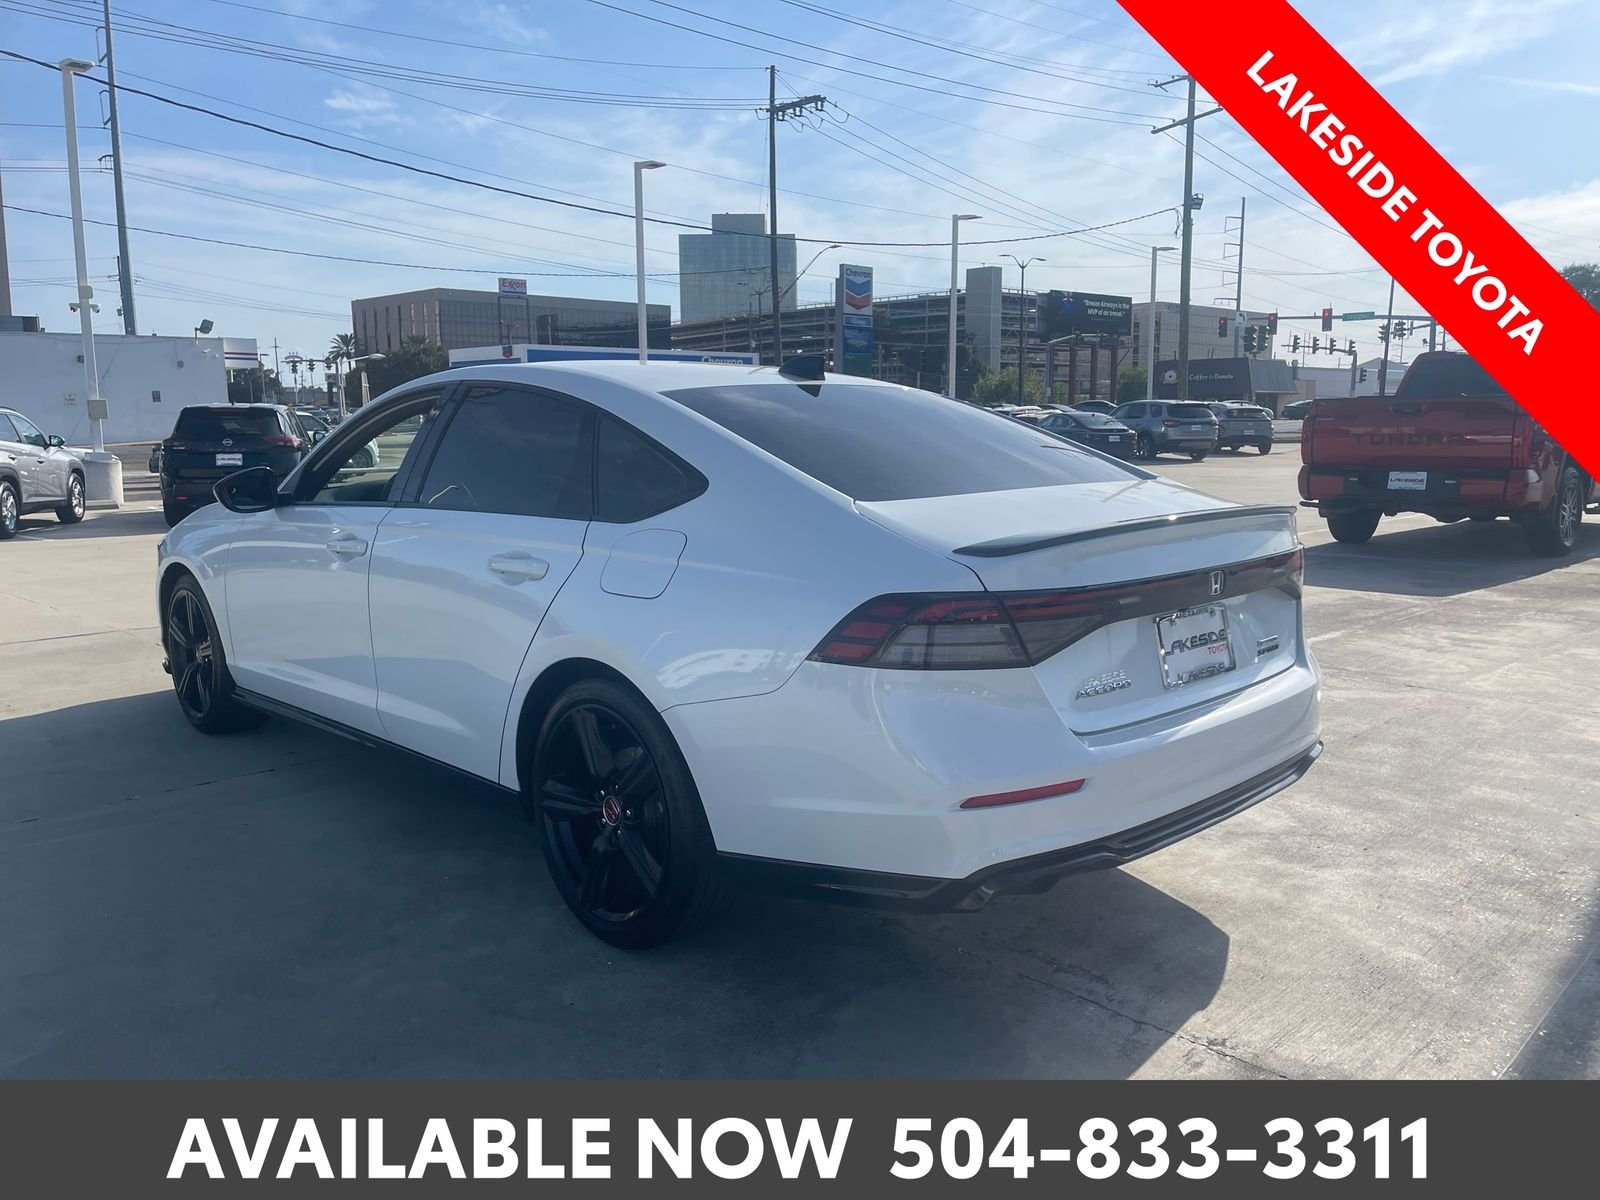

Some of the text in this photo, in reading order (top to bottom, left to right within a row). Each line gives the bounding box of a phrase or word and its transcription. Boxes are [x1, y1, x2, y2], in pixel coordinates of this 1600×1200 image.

[845, 268, 872, 279] Chevron
[502, 279, 527, 290] Exxon
[701, 355, 744, 365] Chevron
[1189, 373, 1208, 381] Coffee
[1214, 372, 1234, 380] Donuts
[1351, 432, 1463, 446] TUNDRA
[1164, 628, 1227, 657] LAKESIDE
[1075, 679, 1132, 700] ACCORD
